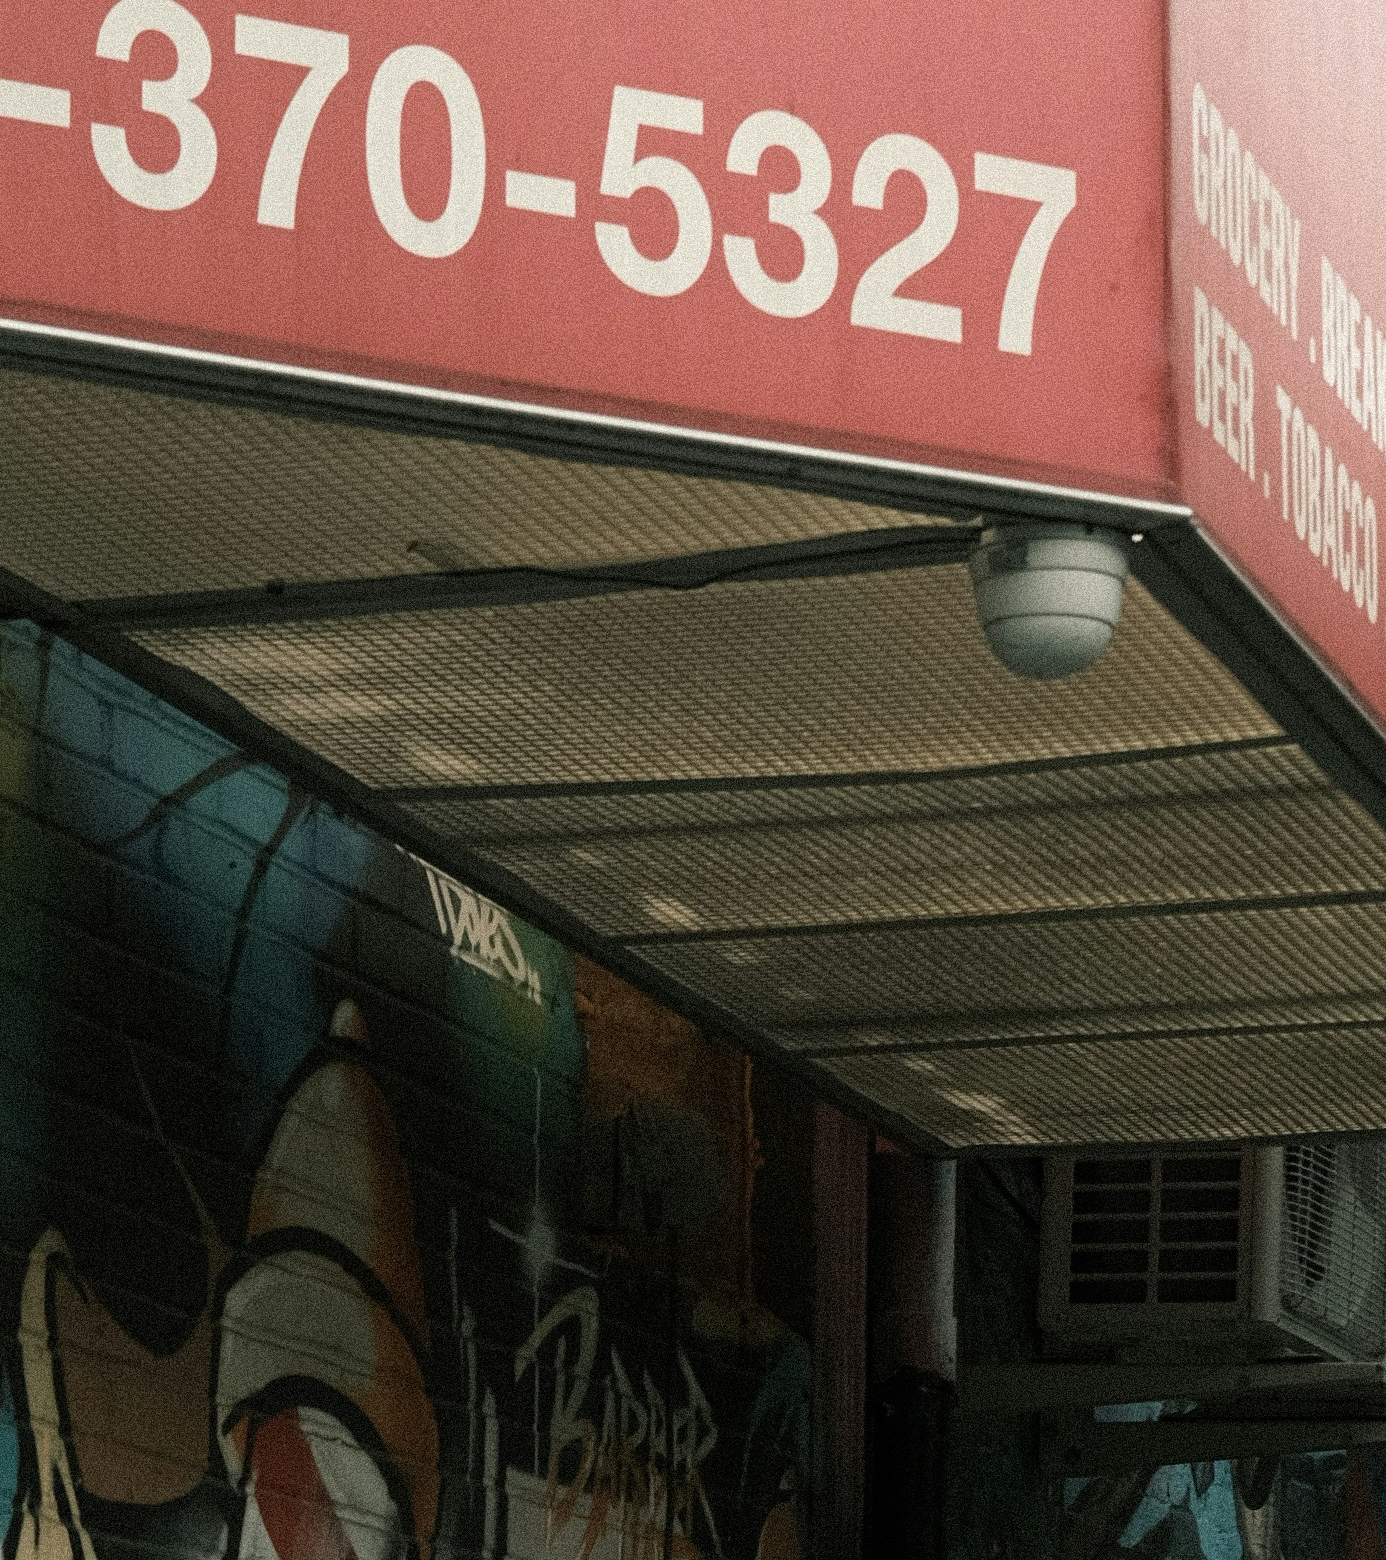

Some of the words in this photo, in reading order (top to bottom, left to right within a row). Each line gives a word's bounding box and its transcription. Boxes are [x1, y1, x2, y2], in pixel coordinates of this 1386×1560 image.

[1192, 82, 1301, 340] GROCERY
[1193, 285, 1256, 482] BEER
[1275, 384, 1379, 624] TOBACCO
